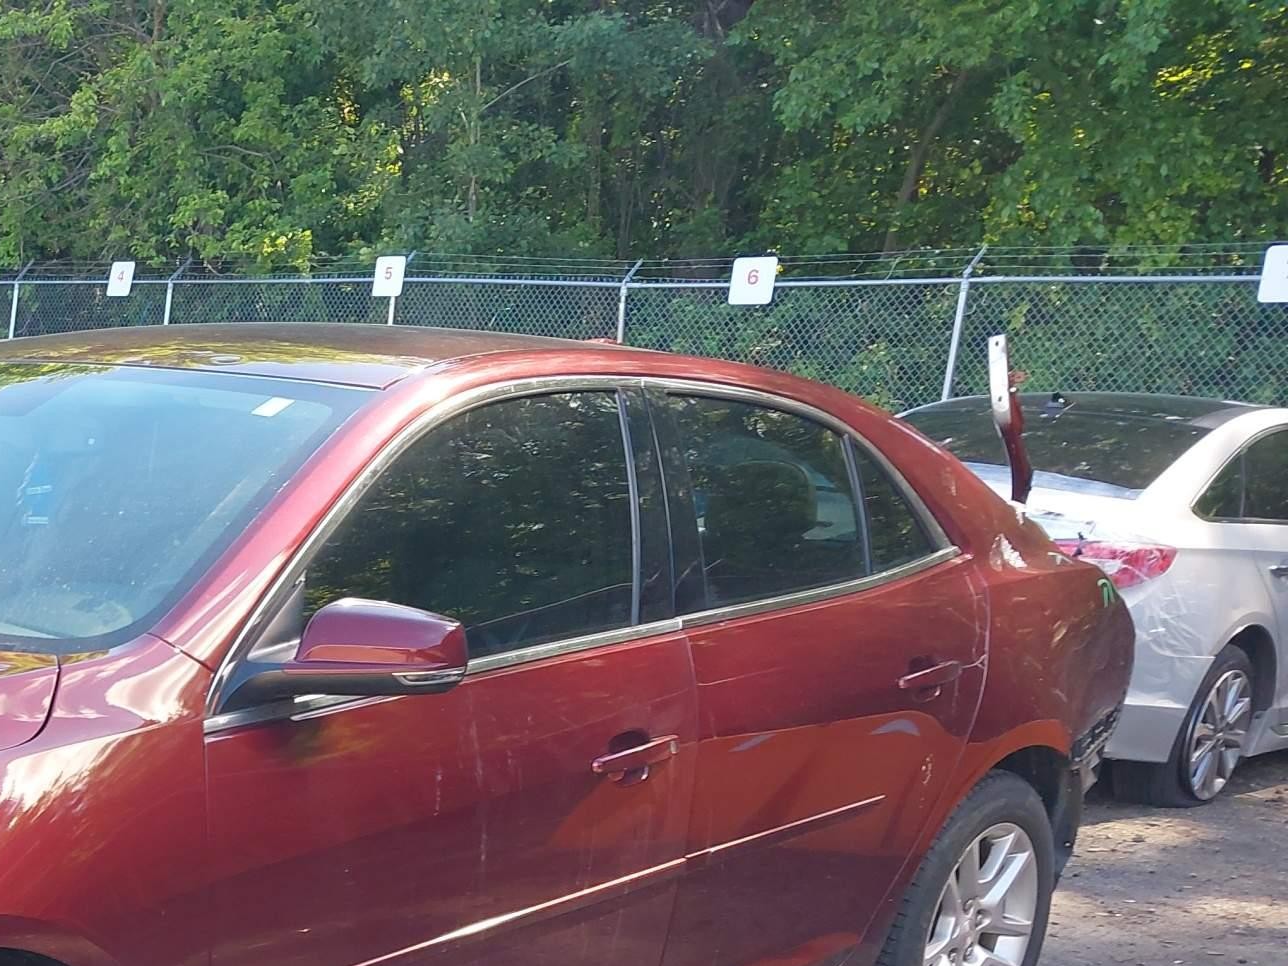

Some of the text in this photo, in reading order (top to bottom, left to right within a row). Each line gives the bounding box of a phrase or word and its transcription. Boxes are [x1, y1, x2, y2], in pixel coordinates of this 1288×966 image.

[117, 270, 125, 282] 4
[384, 267, 393, 281] 5
[747, 269, 759, 286] 6
